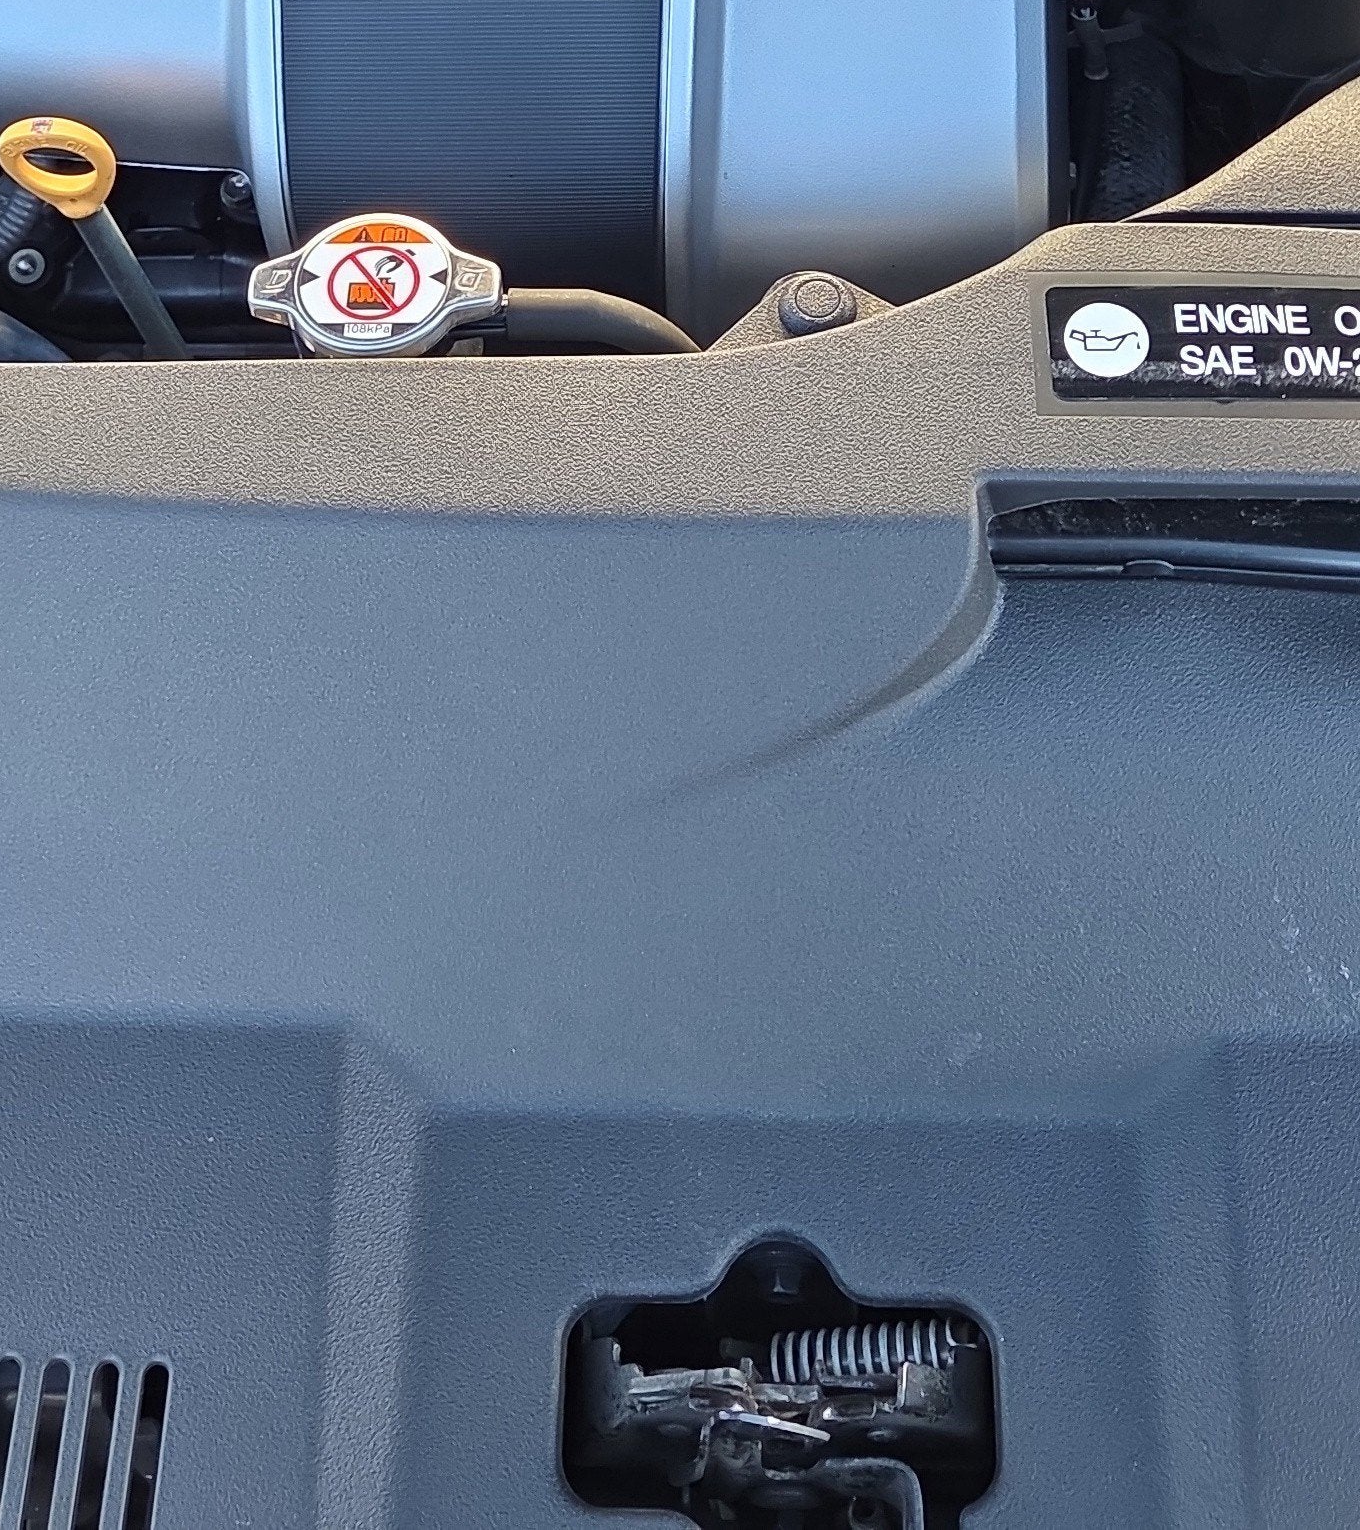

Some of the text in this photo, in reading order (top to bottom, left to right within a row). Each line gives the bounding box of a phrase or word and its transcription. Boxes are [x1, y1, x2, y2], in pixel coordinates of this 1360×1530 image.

[345, 323, 390, 335] 108kPa
[1173, 303, 1311, 336] ENGINE
[1179, 345, 1256, 376] SAE
